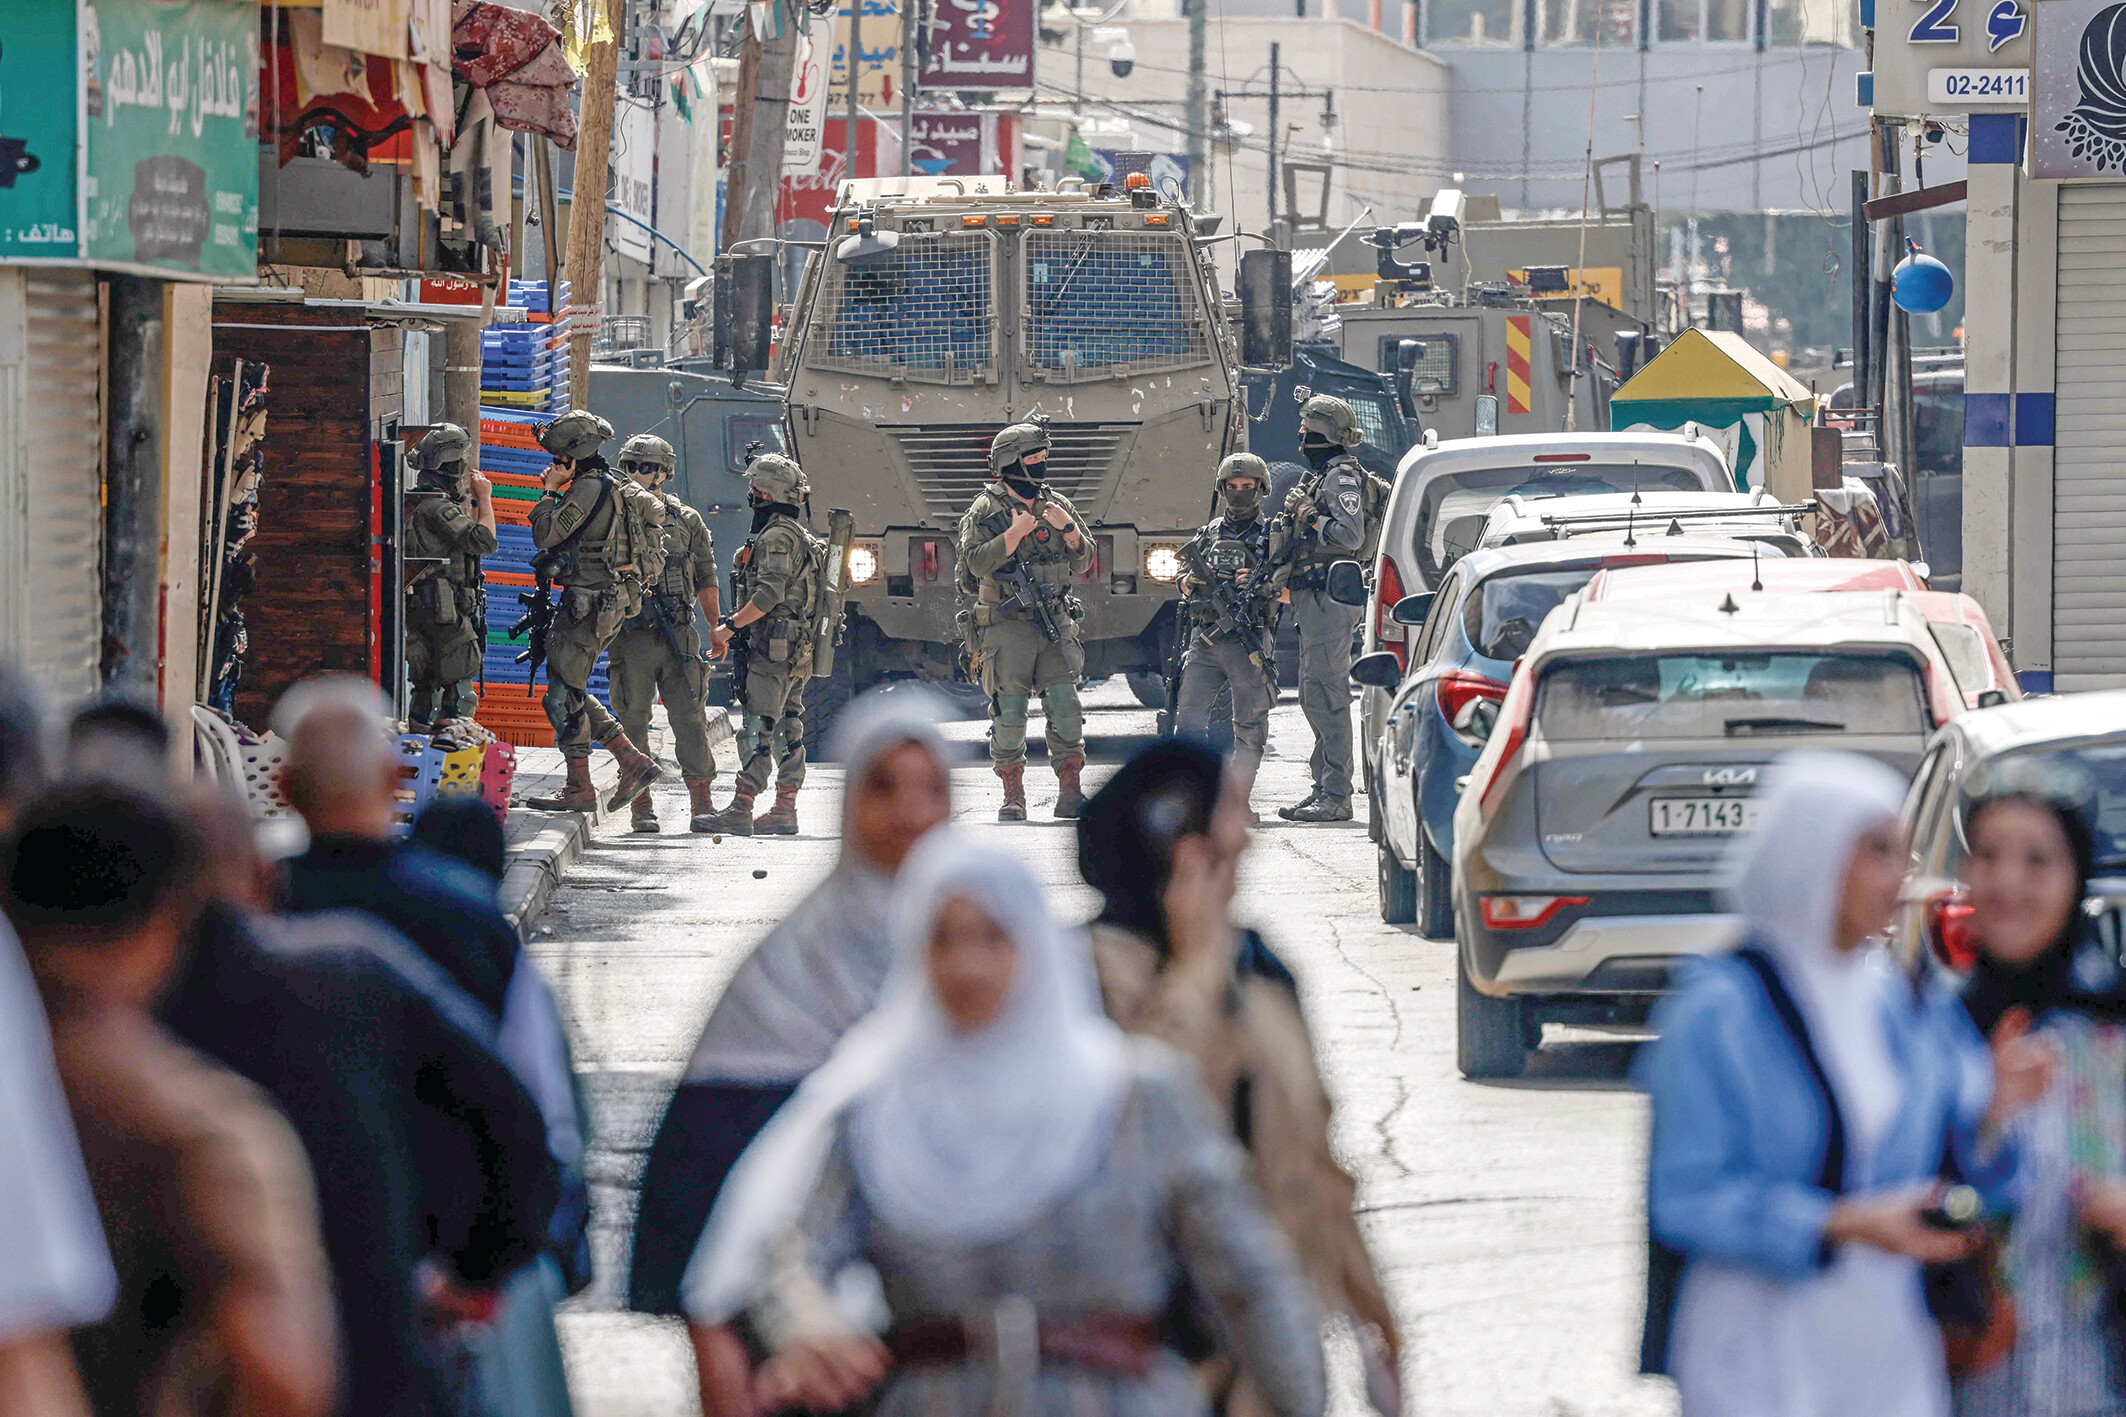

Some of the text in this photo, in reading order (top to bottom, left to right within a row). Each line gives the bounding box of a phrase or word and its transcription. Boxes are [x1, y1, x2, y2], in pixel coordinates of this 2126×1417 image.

[1946, 75, 2030, 95] 02-2411
[789, 109, 811, 124] ONE
[786, 127, 816, 142] MOKER
[911, 120, 979, 146] صيدلي
[18, 223, 75, 243] هاتف
